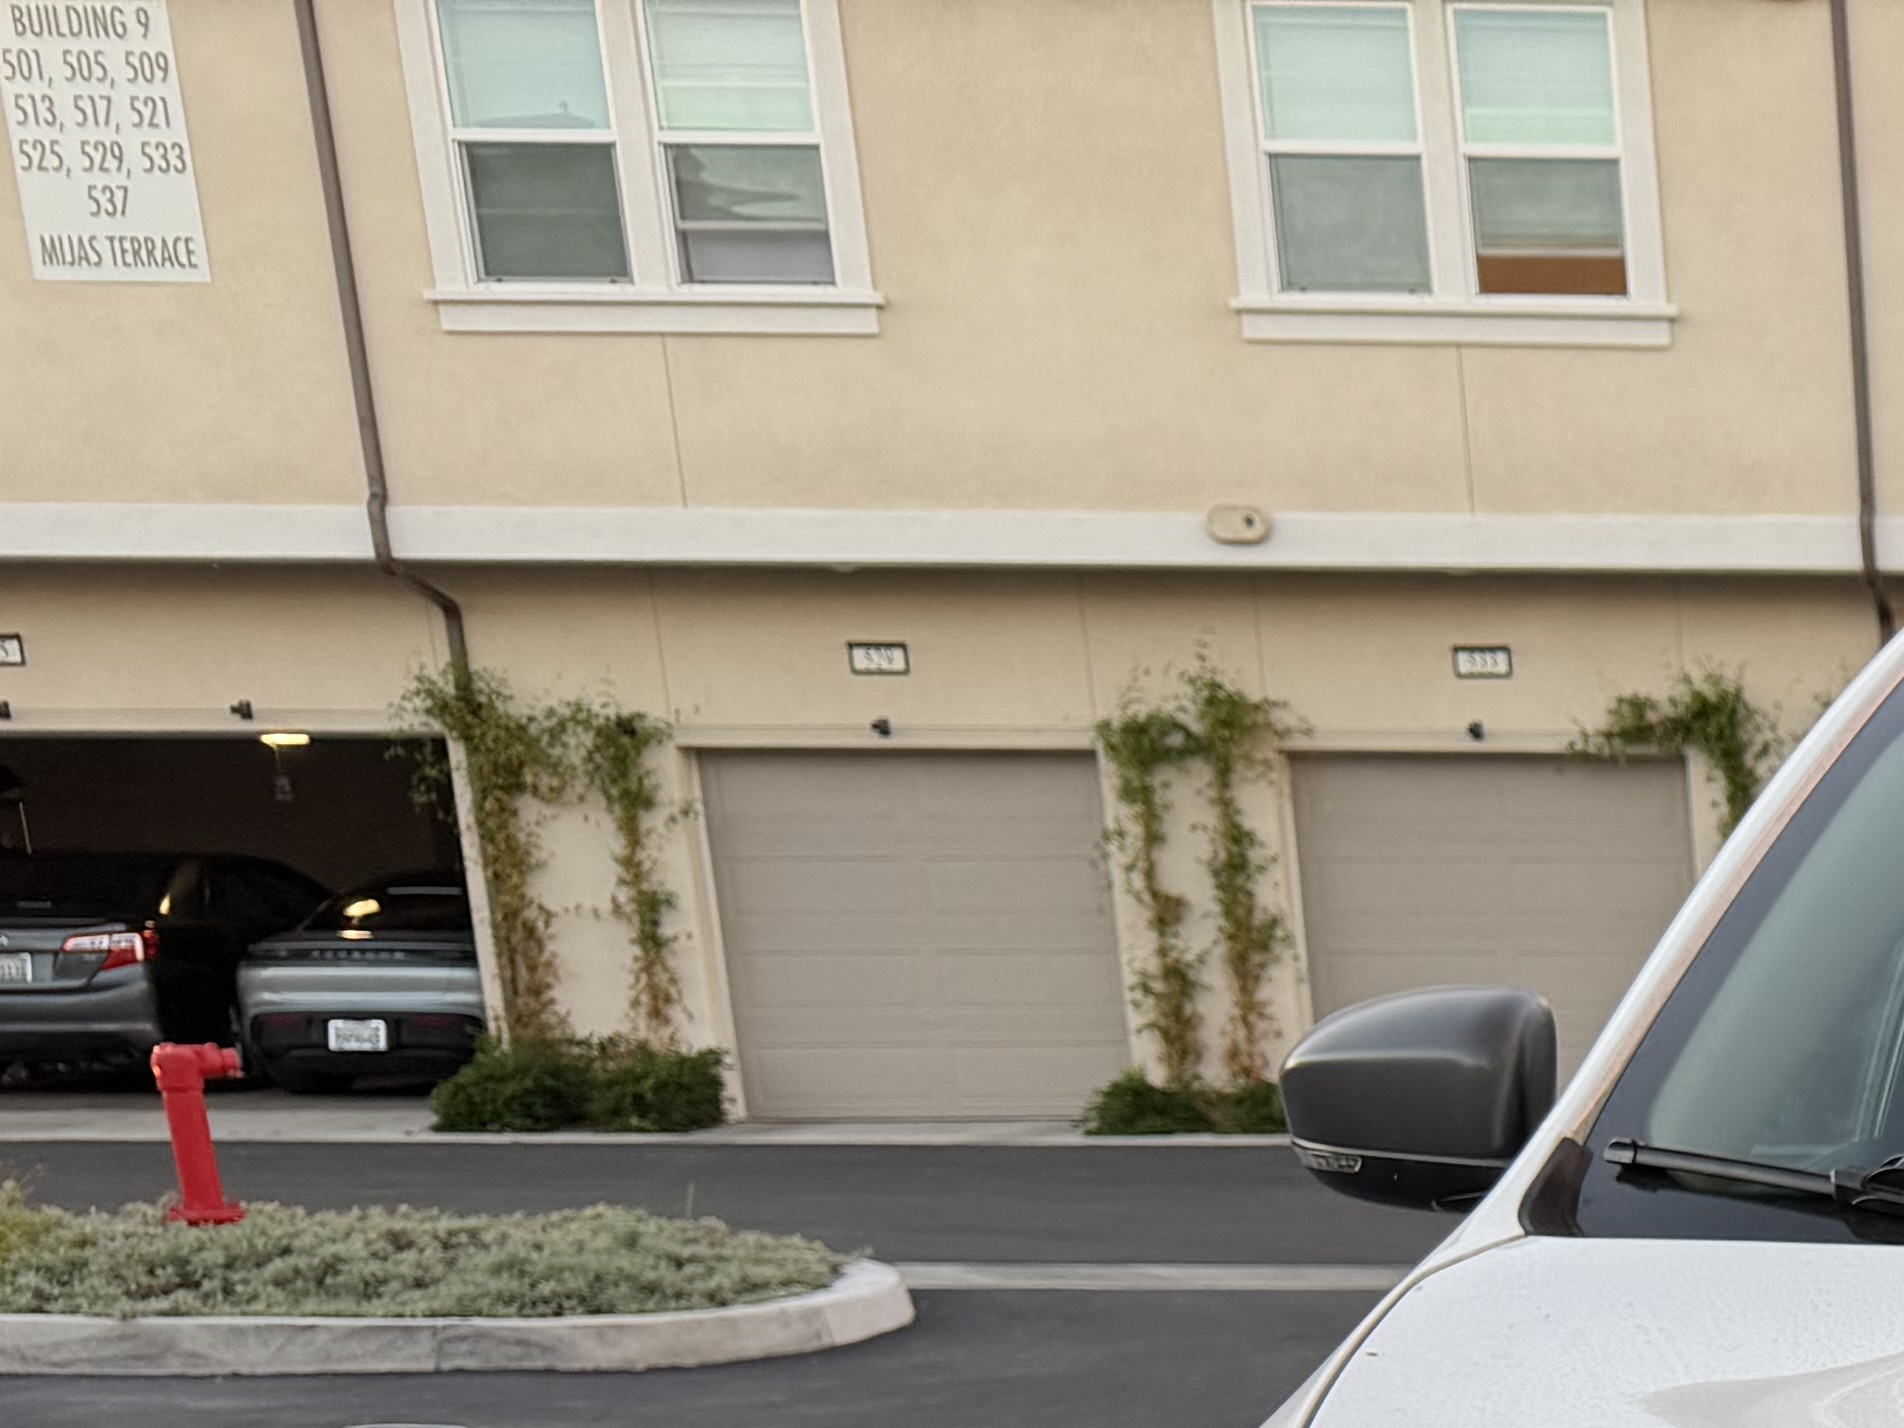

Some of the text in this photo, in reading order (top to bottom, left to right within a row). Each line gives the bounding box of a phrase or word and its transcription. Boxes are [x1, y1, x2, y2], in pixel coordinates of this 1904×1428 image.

[11, 4, 150, 40] BUILDING 9
[2, 48, 169, 89] 501, 505, 509
[14, 93, 171, 134] 513, 517, 521
[19, 139, 187, 179] 525, 529, 533
[87, 185, 129, 217] 537
[40, 234, 199, 270] MIJAS TERRACE
